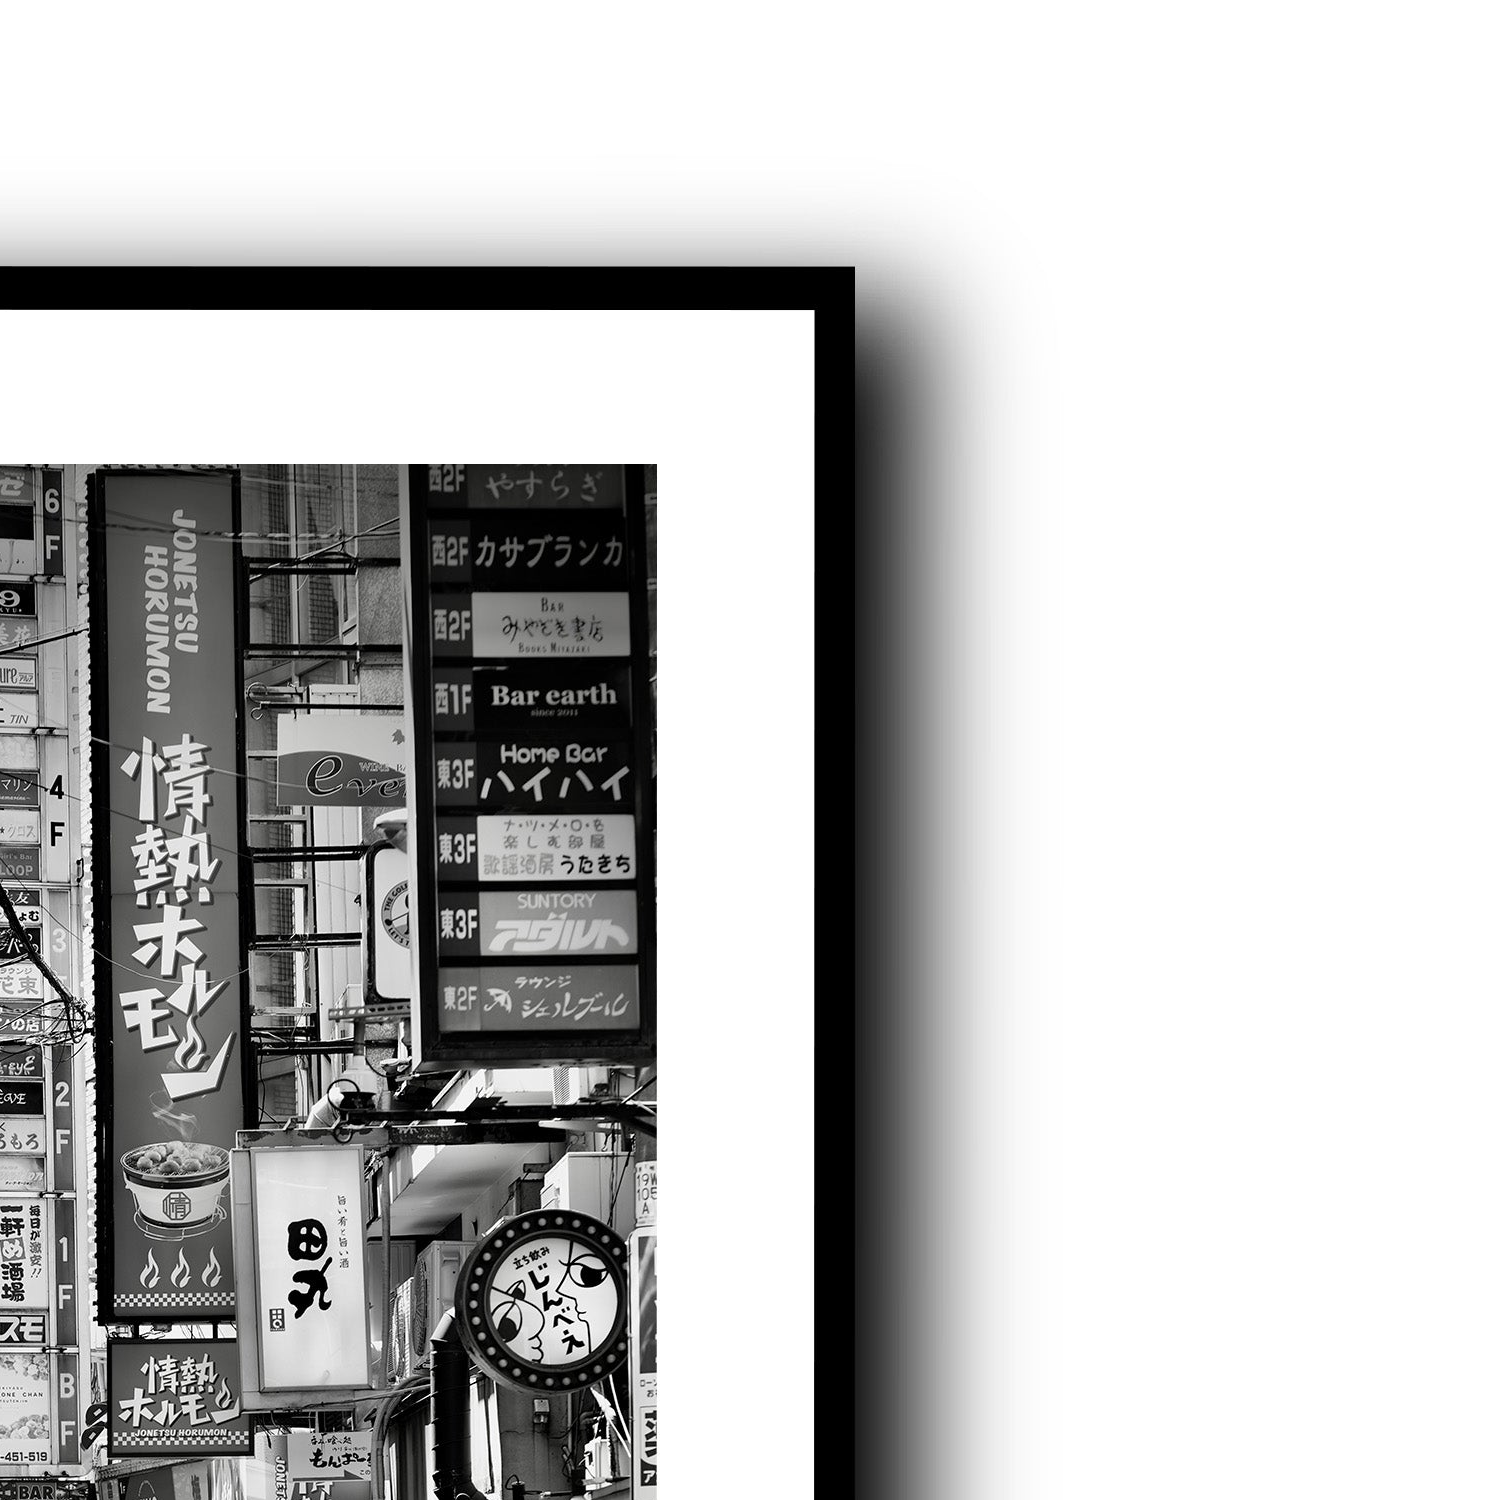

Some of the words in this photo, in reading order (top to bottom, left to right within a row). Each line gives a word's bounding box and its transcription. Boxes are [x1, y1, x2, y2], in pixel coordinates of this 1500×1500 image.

[485, 470, 603, 502] やすらぎ
[431, 534, 469, 567] 西2F
[475, 534, 623, 568] カサブランカ
[172, 508, 200, 653] JONETSU
[143, 544, 171, 714] HORUMON
[434, 609, 471, 641] 西2F
[435, 683, 472, 715] 西1F
[491, 685, 541, 706] Bar
[546, 683, 618, 706] earth
[10, 714, 29, 724] TIN
[500, 743, 560, 764] Home
[565, 743, 609, 764] Bar
[437, 758, 475, 789] 東3F
[480, 765, 630, 802] ハイハイ
[438, 832, 476, 864] 東3F
[560, 854, 631, 875] うたきち
[119, 733, 237, 1102] 情熱ホルモン
[517, 893, 596, 910] SUNTORY
[440, 908, 478, 939] 東3F
[488, 912, 630, 952] アダルト
[514, 975, 572, 988] ラウンジ
[443, 985, 478, 1011] 東2F
[0, 1204, 27, 1303] 一軒め酒場
[512, 1246, 550, 1271] 立ち飲み
[140, 1353, 219, 1395] 情熱
[117, 1385, 242, 1428] ホルモン
[135, 1428, 177, 1438] JONETSU
[177, 1428, 228, 1437] HORUMON
[18, 1484, 55, 1500] BAR
